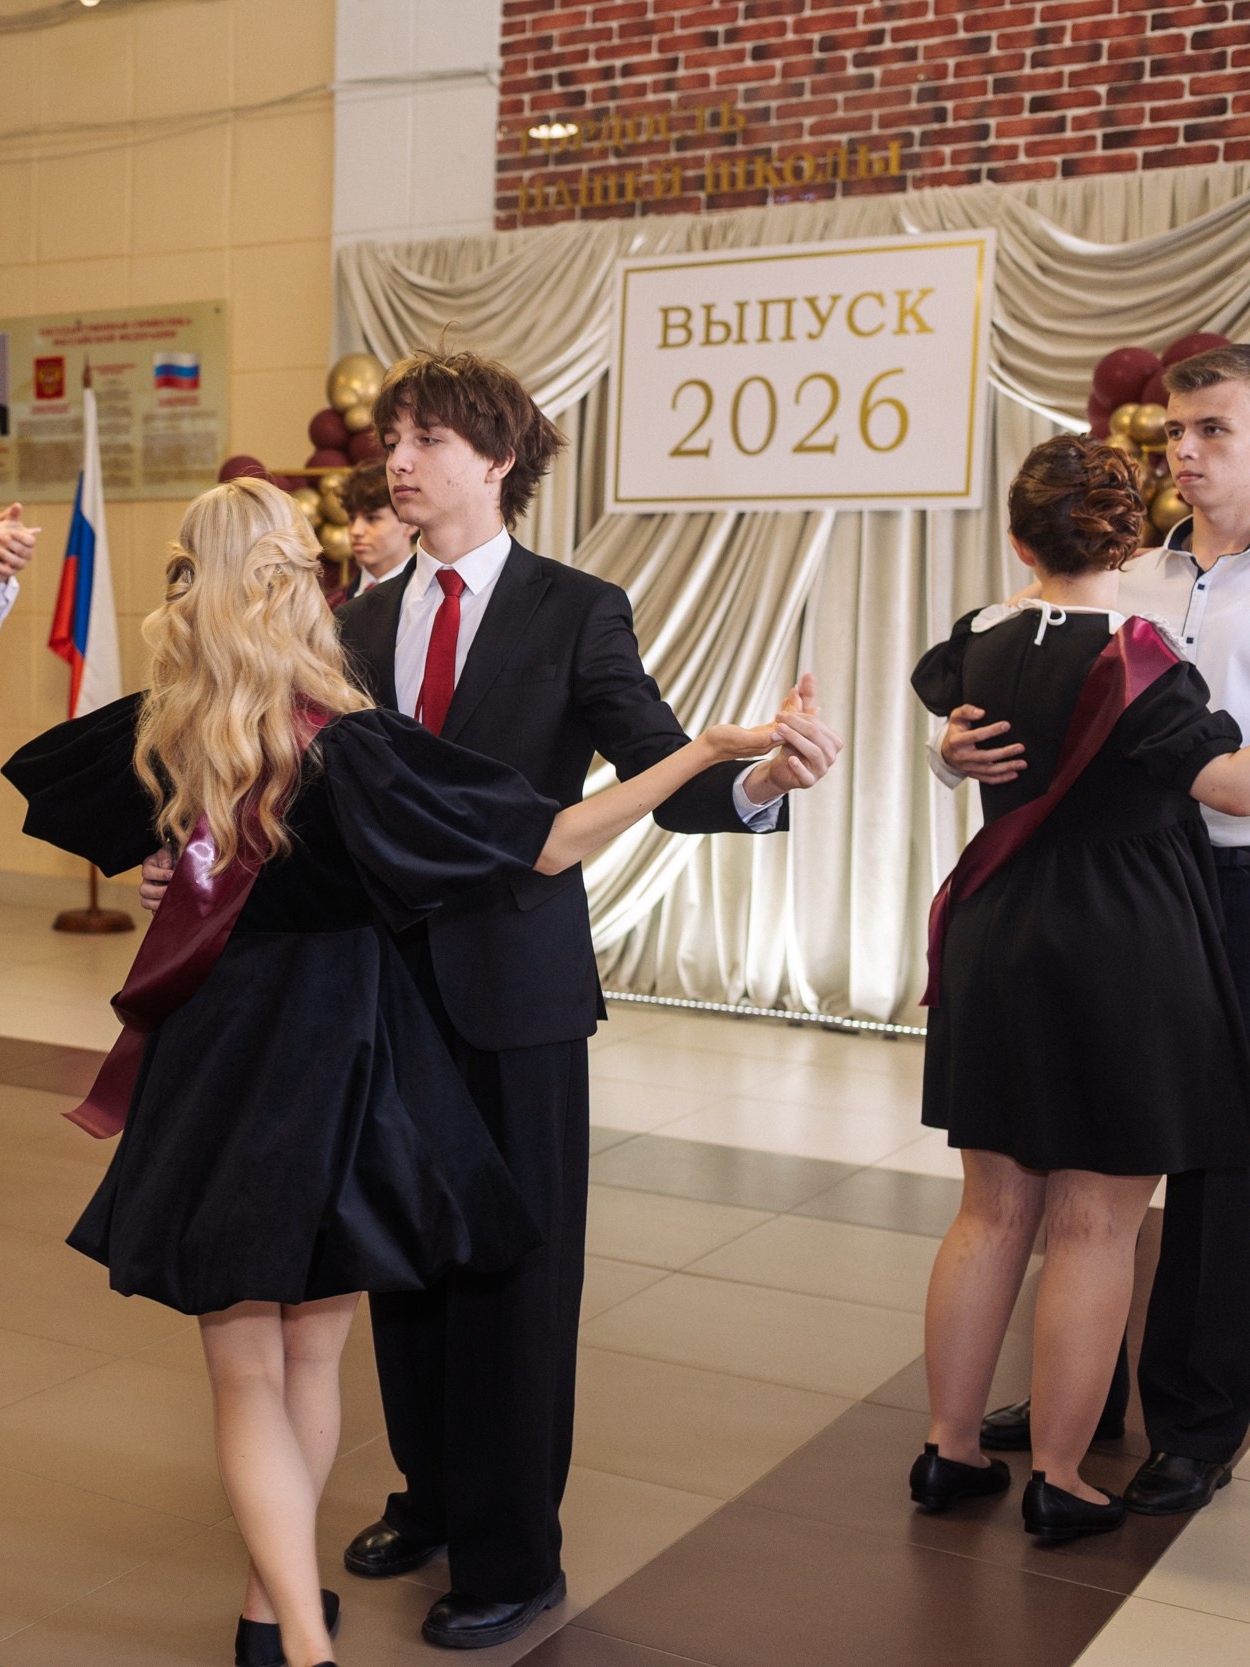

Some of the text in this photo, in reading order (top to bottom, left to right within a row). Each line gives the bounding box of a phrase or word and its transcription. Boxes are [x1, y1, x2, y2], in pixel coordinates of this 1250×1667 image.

[518, 140, 904, 214] НАШЕЙ ШКОЛЫ
[657, 287, 935, 350] ВЫПУСК
[668, 367, 910, 459] 2026
